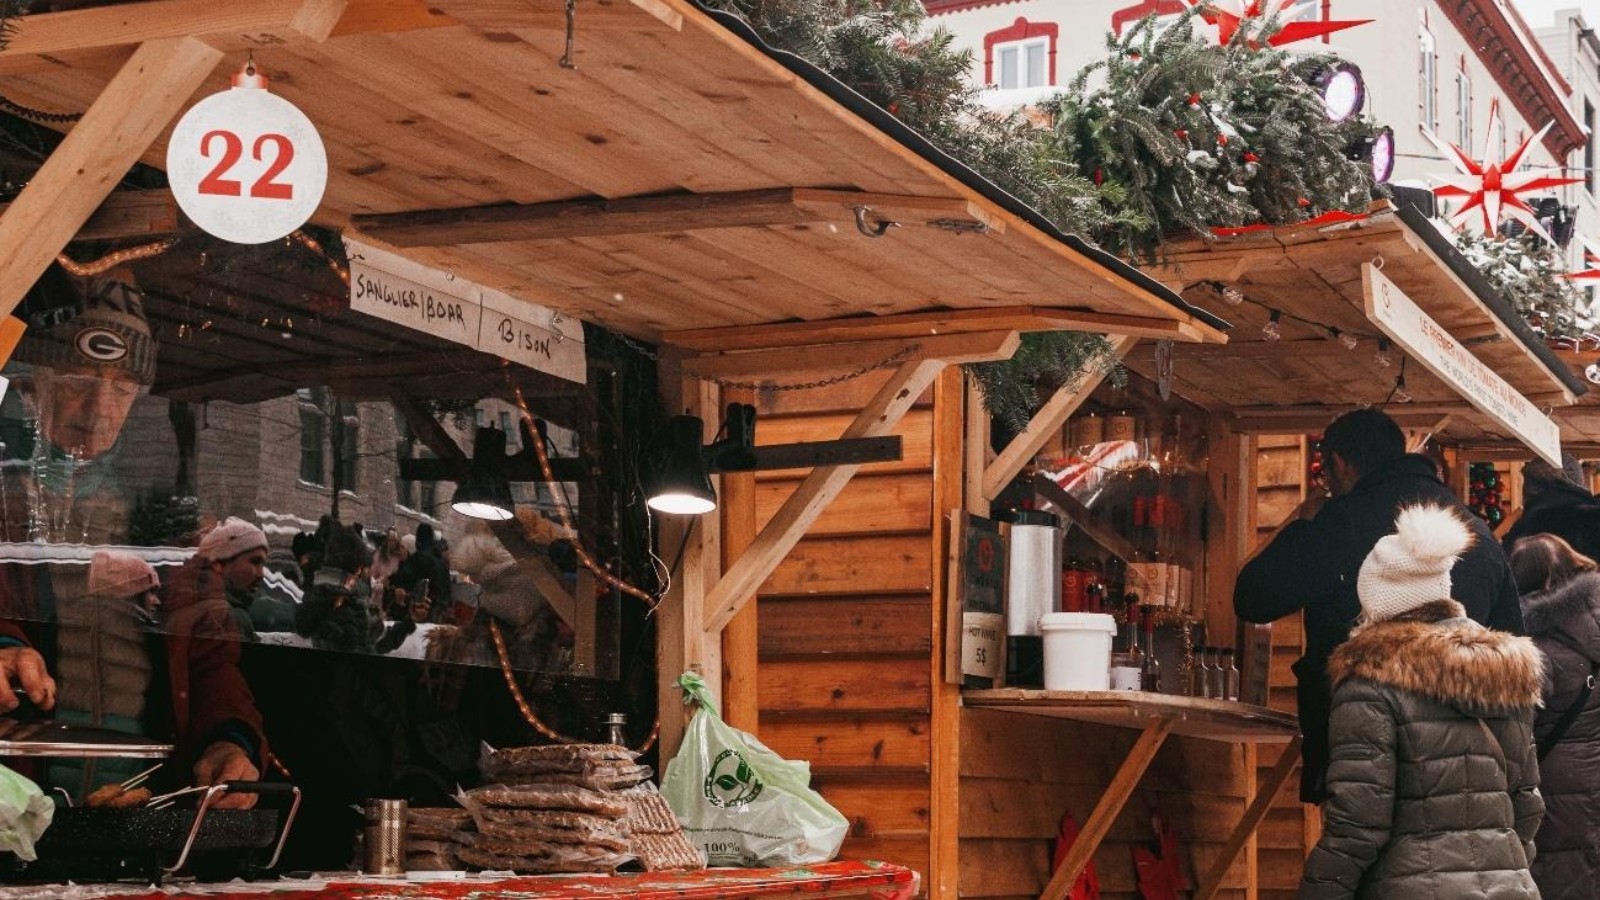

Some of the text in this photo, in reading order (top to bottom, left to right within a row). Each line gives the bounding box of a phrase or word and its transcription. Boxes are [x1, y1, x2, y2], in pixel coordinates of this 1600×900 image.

[198, 130, 295, 200] 22
[498, 318, 551, 360] BISON
[976, 647, 986, 667] 5$
[703, 842, 740, 853] 100%
